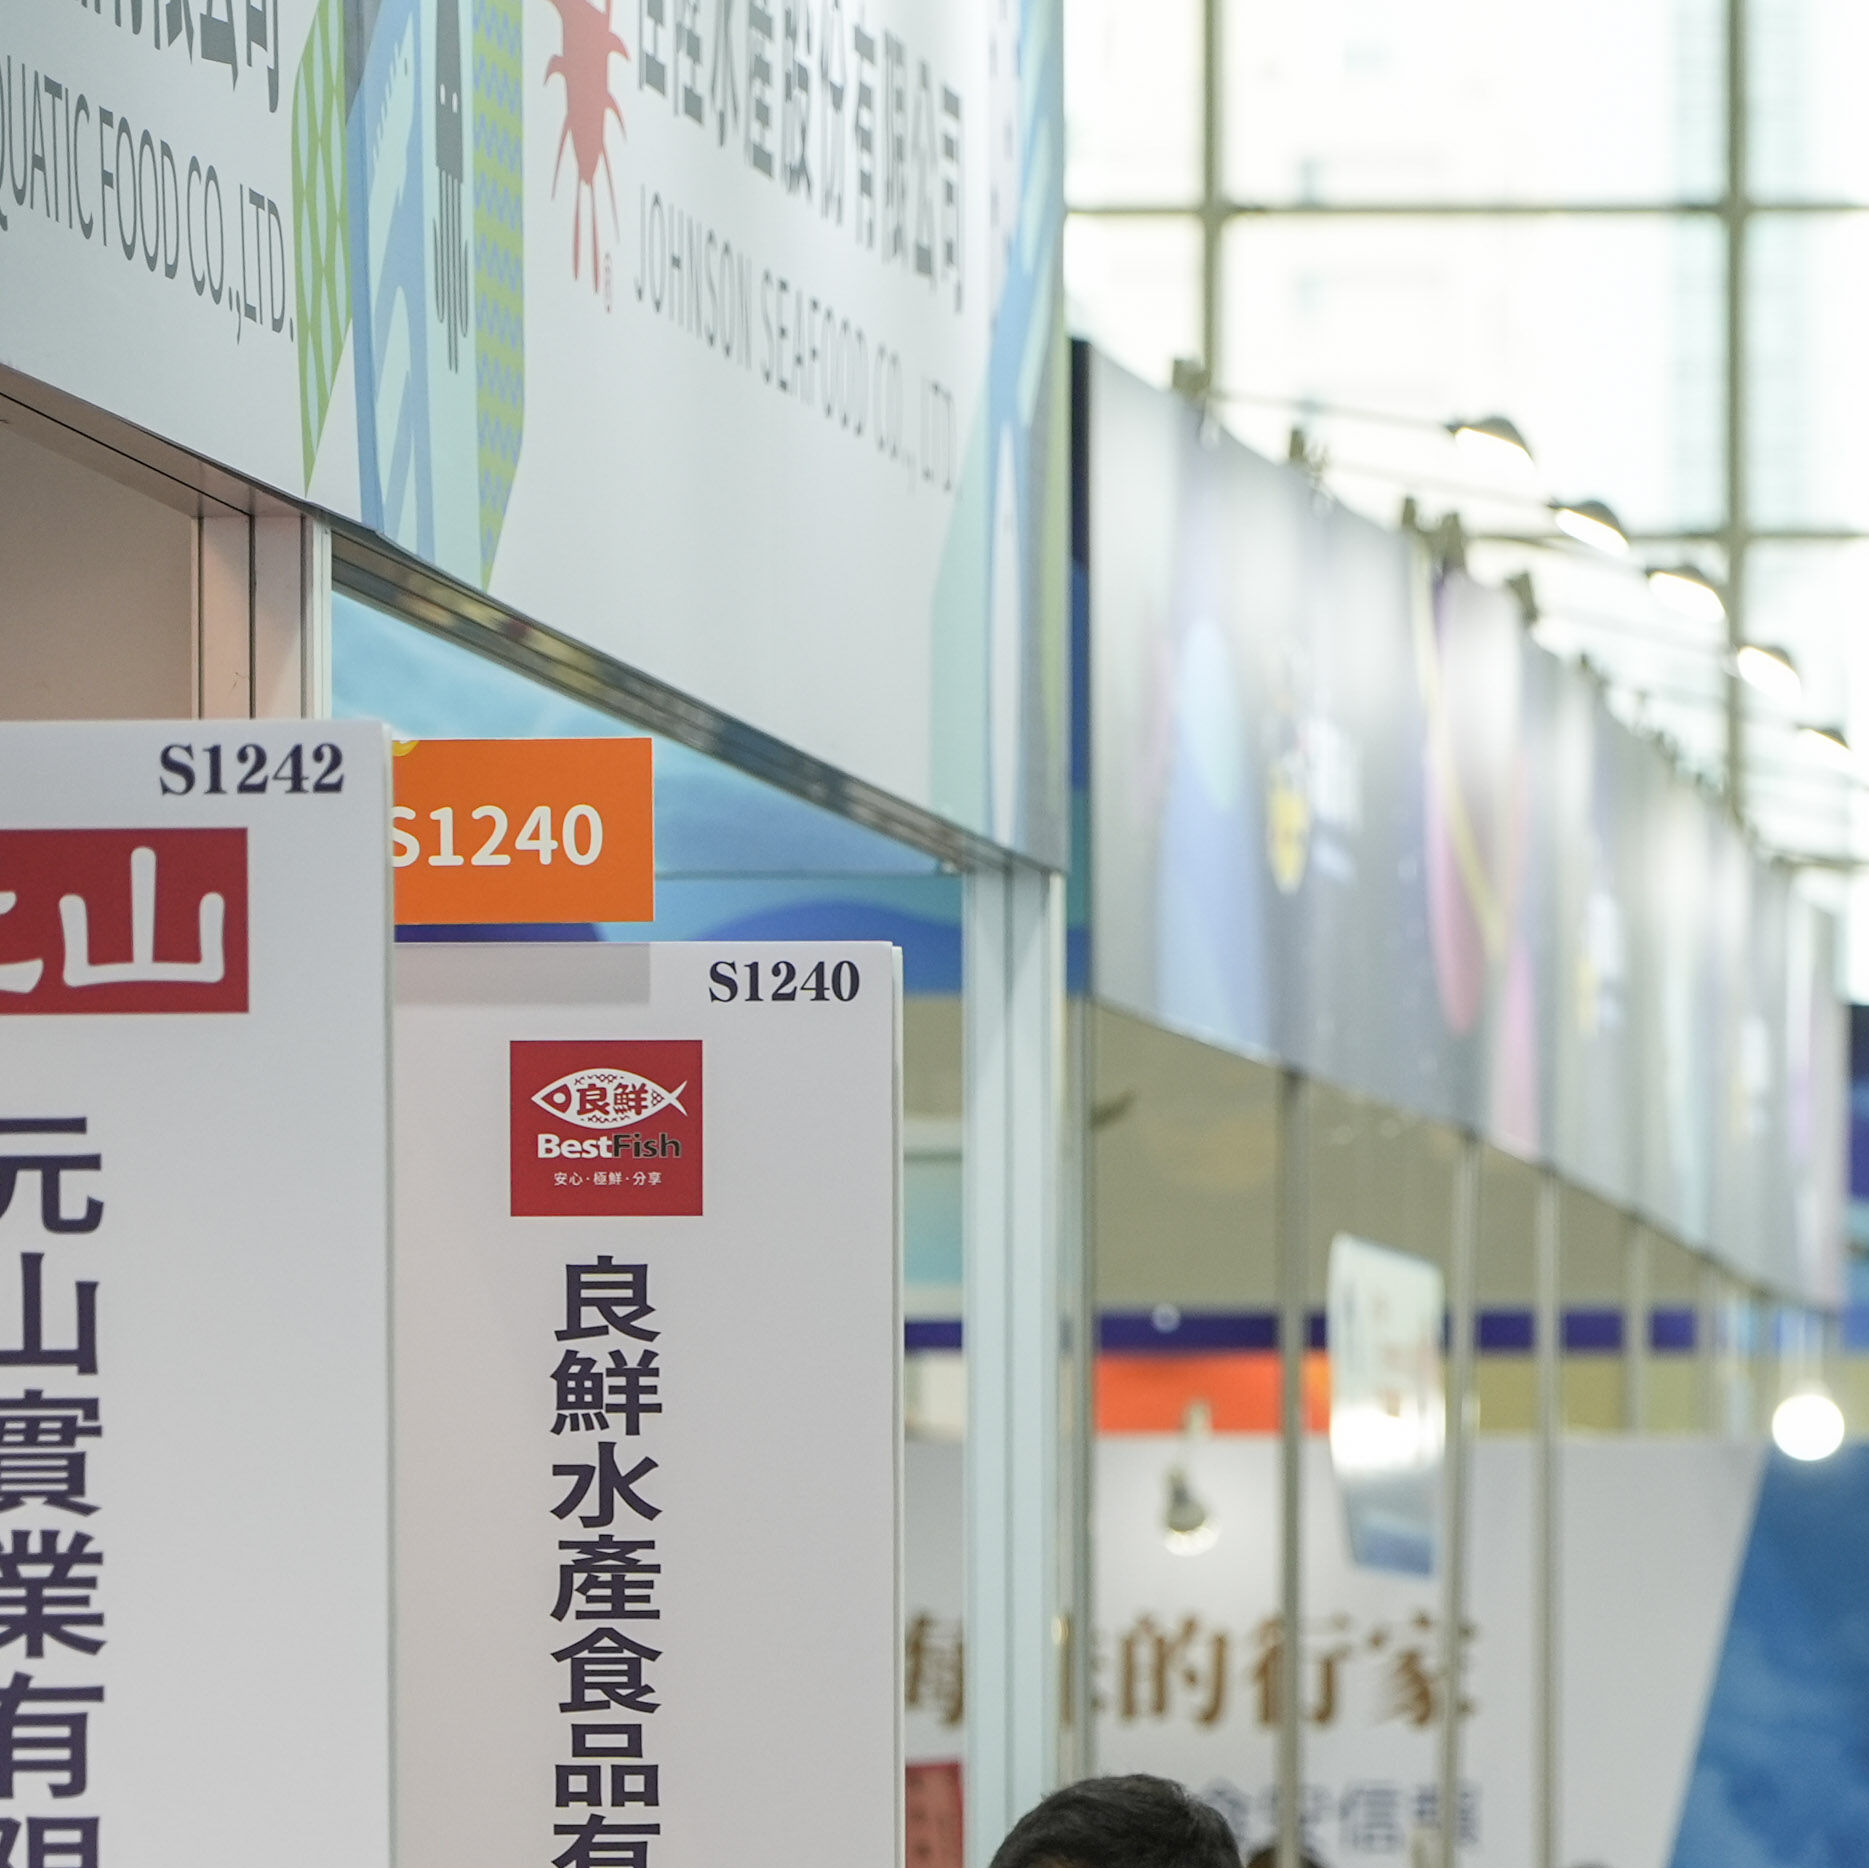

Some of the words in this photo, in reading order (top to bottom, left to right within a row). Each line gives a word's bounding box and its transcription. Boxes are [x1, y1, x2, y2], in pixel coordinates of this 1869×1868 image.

[0, 55, 93, 240] UATIC
[99, 106, 179, 280] FOOD
[634, 182, 752, 371] JOHNSON
[760, 268, 869, 440] SEAFOOD
[159, 742, 346, 796] S1242
[393, 805, 604, 867] S1240
[708, 960, 861, 1003] S1240
[576, 1083, 649, 1116] 良鮮
[537, 1133, 682, 1159] BestFish
